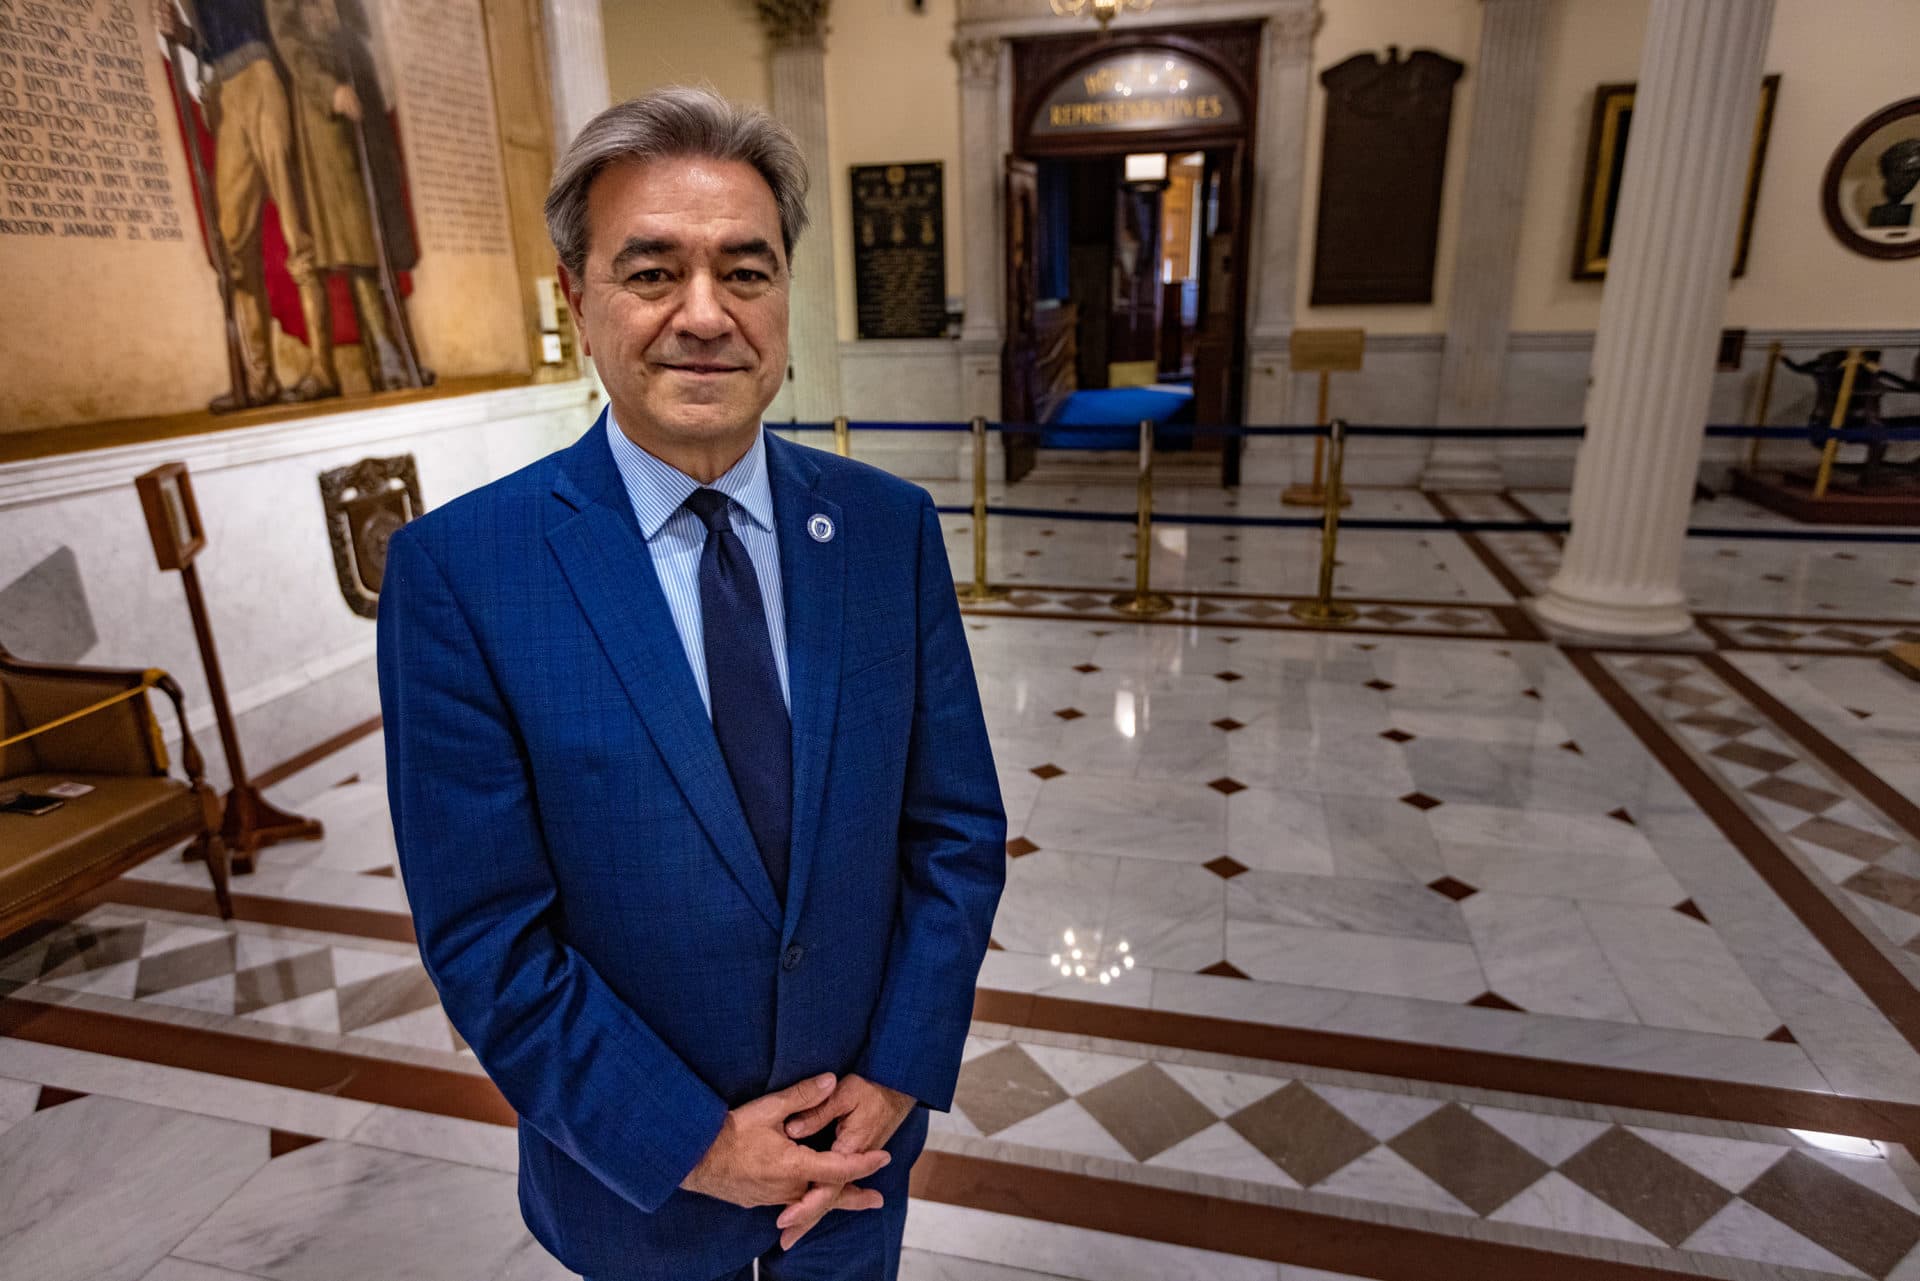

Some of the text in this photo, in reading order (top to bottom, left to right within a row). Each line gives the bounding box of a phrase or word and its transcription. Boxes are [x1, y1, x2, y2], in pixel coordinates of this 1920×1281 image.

[100, 17, 139, 41] AND
[72, 48, 90, 66] AT
[83, 32, 144, 61] SOUTH
[94, 71, 112, 88] AT
[117, 73, 150, 94] THE
[24, 93, 54, 114] TO
[56, 98, 110, 122] PORTO
[115, 107, 158, 129] RICO
[92, 120, 127, 140] THAT
[48, 132, 140, 157] ENGAGED
[49, 150, 93, 170] ROAD
[7, 182, 50, 200] FROM
[55, 187, 84, 203] SAN
[8, 200, 27, 217] IN
[31, 203, 87, 219] BOSTON
